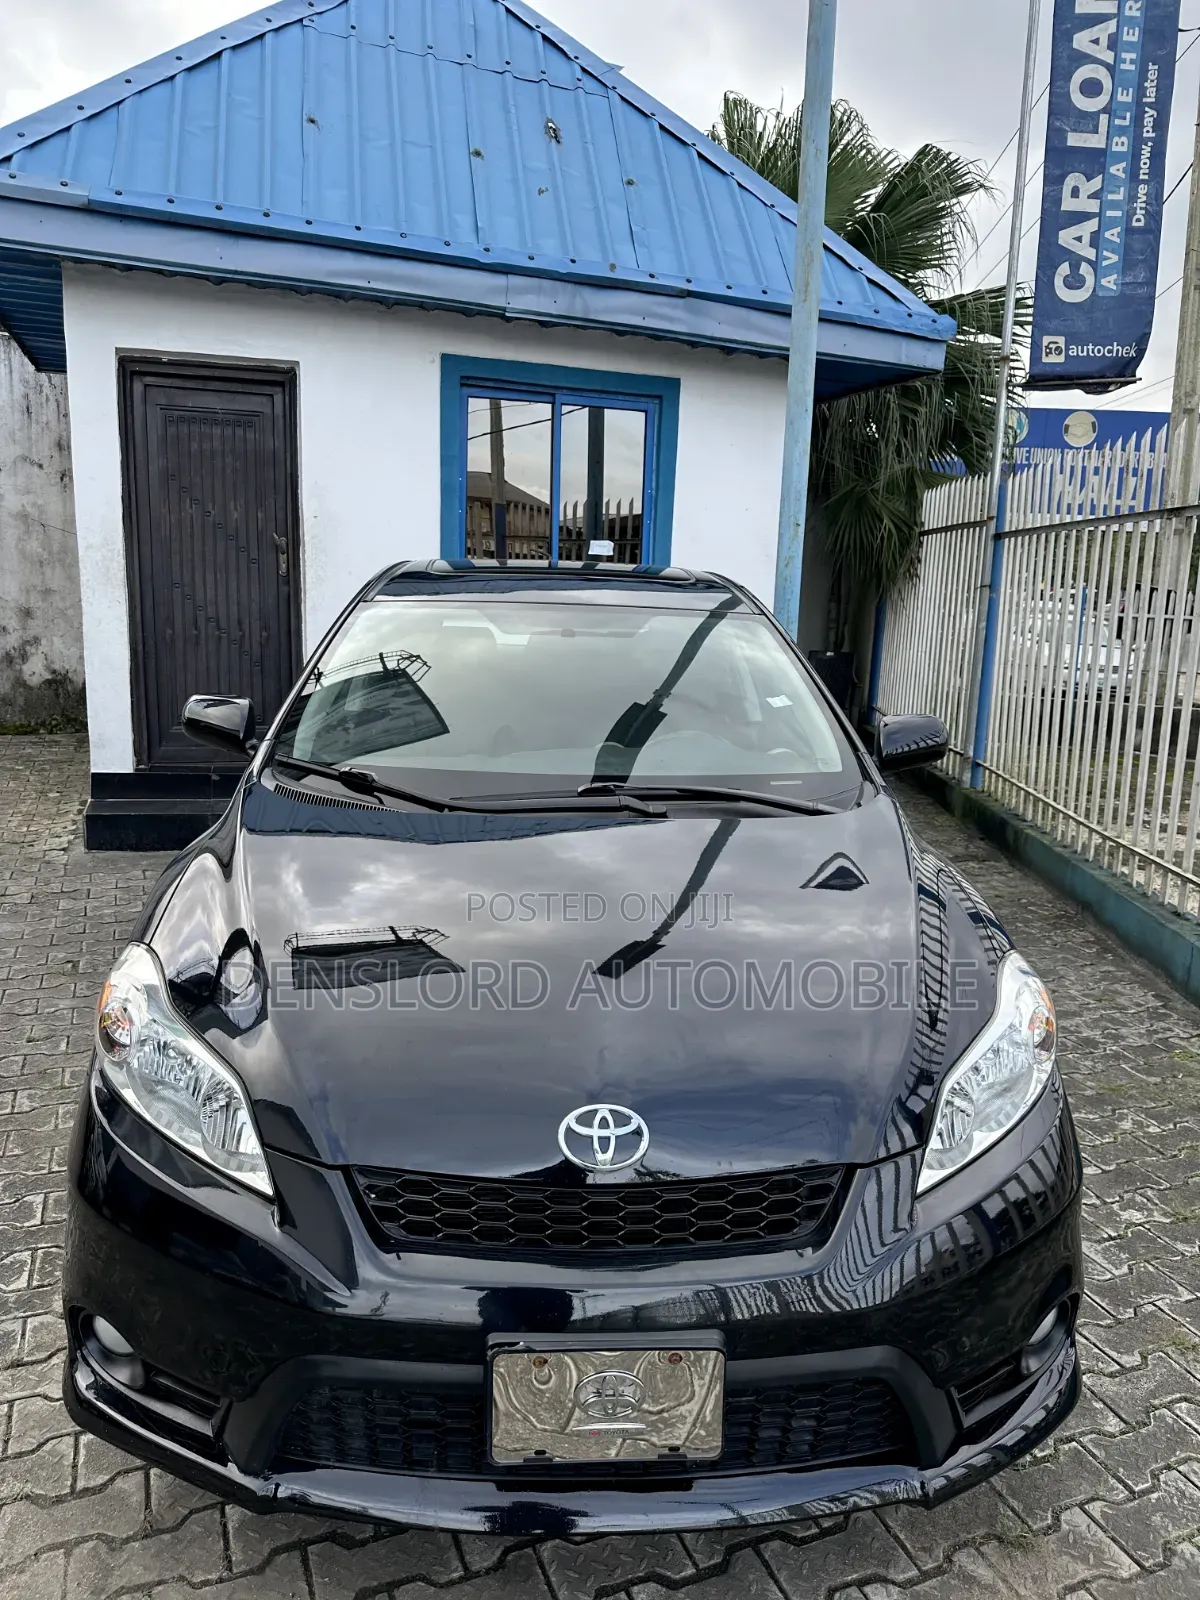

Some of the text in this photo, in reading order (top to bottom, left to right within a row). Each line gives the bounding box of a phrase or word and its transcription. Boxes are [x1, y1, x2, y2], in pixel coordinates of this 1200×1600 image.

[1101, 87, 1133, 290] AVAILABLE
[1132, 63, 1159, 227] Drive now, pay later
[1054, 172, 1103, 303] CAR
[1068, 342, 1138, 358] autochek
